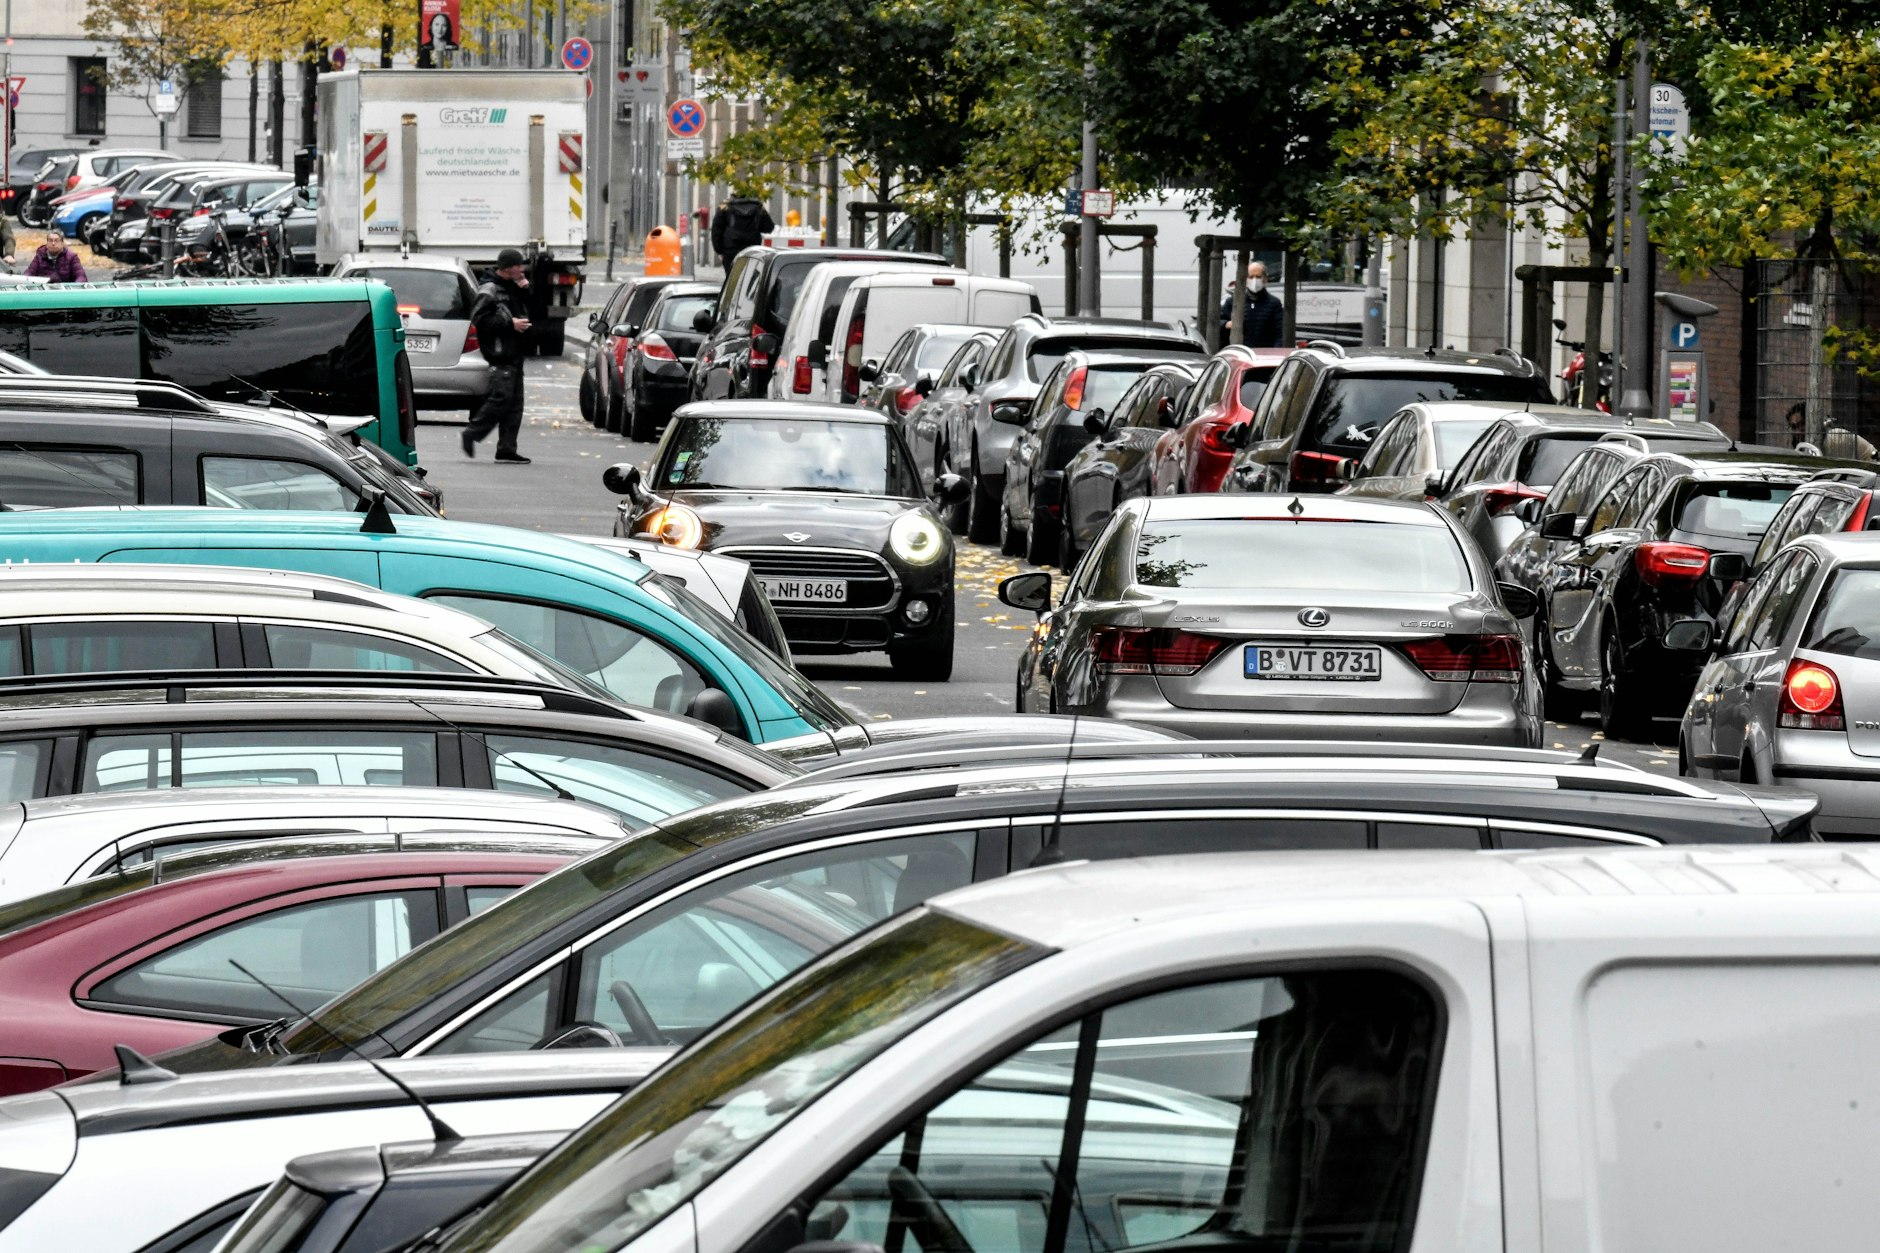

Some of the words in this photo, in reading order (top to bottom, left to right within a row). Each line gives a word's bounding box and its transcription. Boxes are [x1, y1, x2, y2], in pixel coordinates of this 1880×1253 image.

[1656, 90, 1670, 102] 30
[440, 107, 489, 124] Greif
[419, 147, 454, 155] Laufend
[457, 147, 484, 155] frische
[488, 147, 521, 155] Wäsche
[436, 157, 509, 166] deutschlandweit
[425, 168, 520, 176] www.mietwaesche.de
[1679, 323, 1696, 347] P
[407, 340, 430, 349] 5352
[778, 582, 800, 598] NH
[804, 583, 844, 599] 8486
[1259, 650, 1273, 671] B
[1288, 650, 1317, 672] VT
[1322, 651, 1377, 673] 8731
